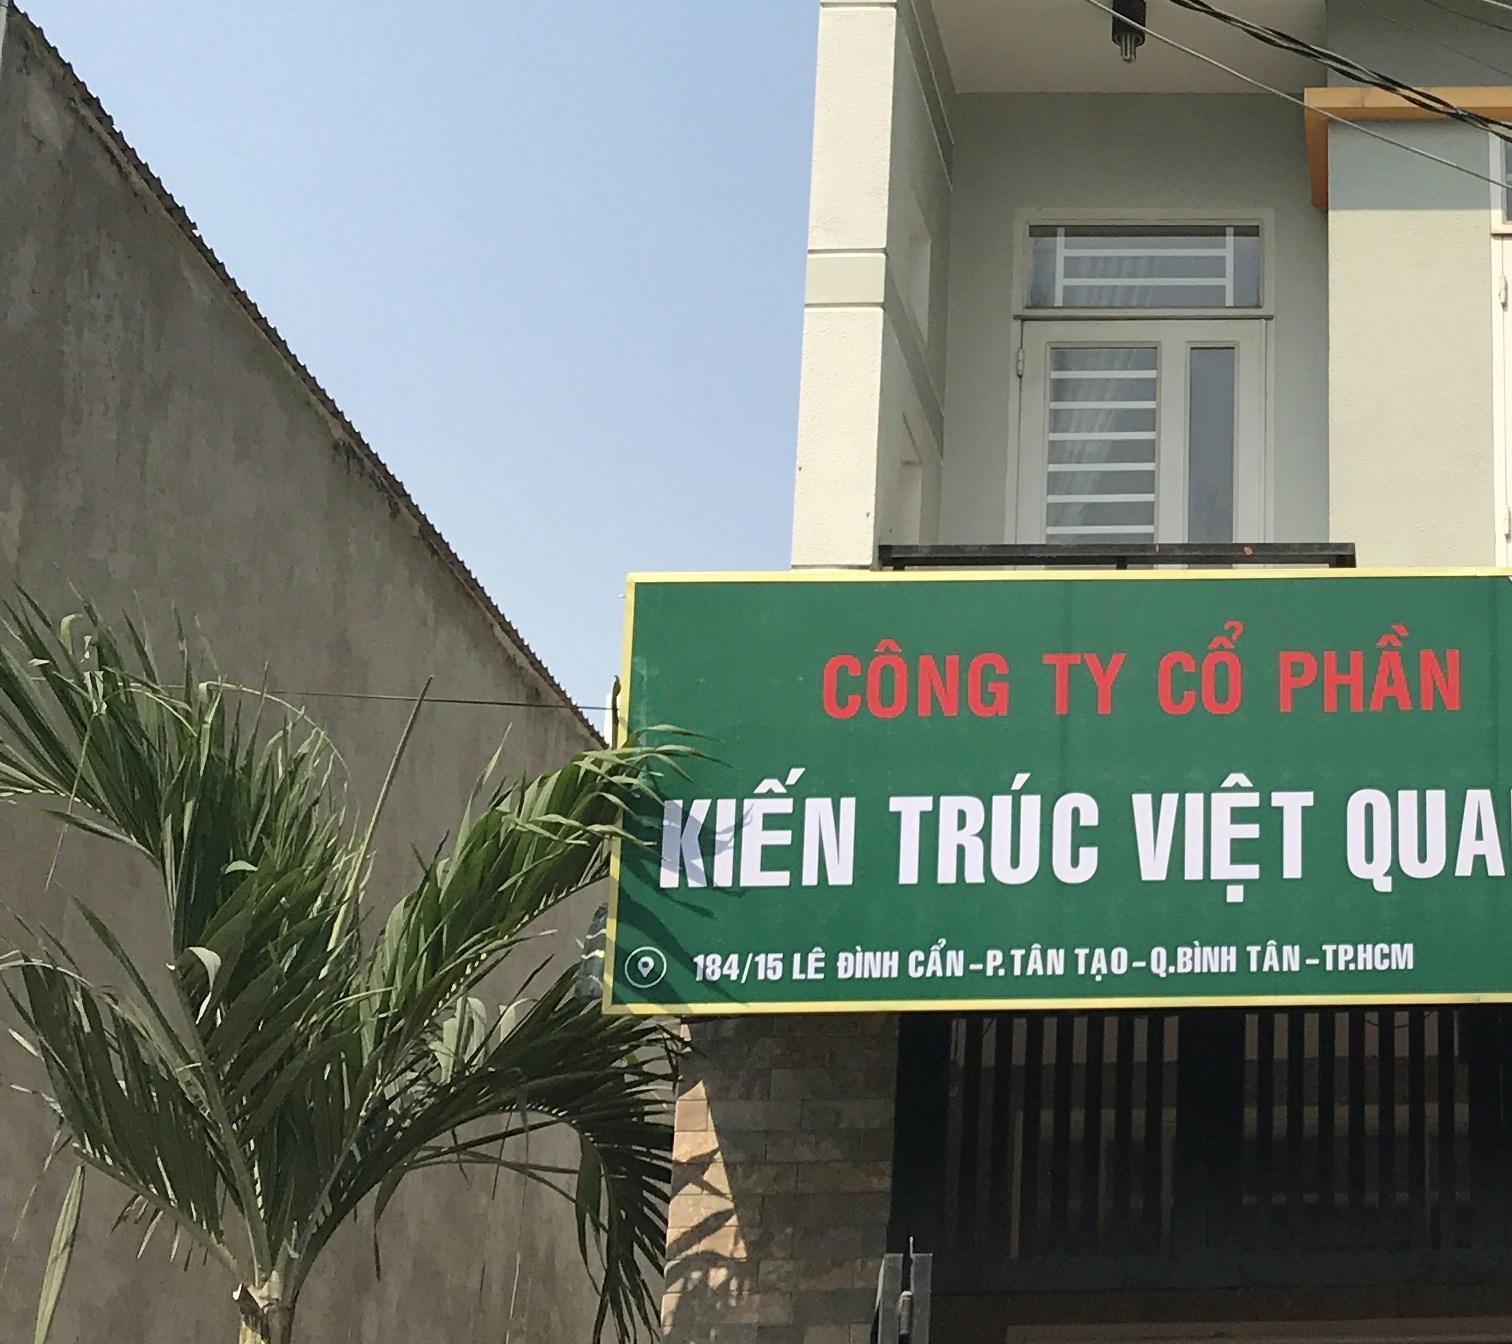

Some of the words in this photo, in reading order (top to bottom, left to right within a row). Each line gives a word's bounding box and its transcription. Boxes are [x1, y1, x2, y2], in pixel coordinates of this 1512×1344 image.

[823, 639, 1009, 719] CÔNG
[1043, 653, 1125, 715] TY
[1158, 620, 1243, 715] CỔ
[1279, 623, 1461, 712] PHẦN
[659, 767, 857, 889] KIẾN
[888, 771, 1100, 886] TRÚC
[1131, 771, 1315, 904] VIỆT
[693, 952, 784, 984] 184/15
[792, 946, 826, 980] LÊ
[836, 945, 899, 979] ĐÌNH
